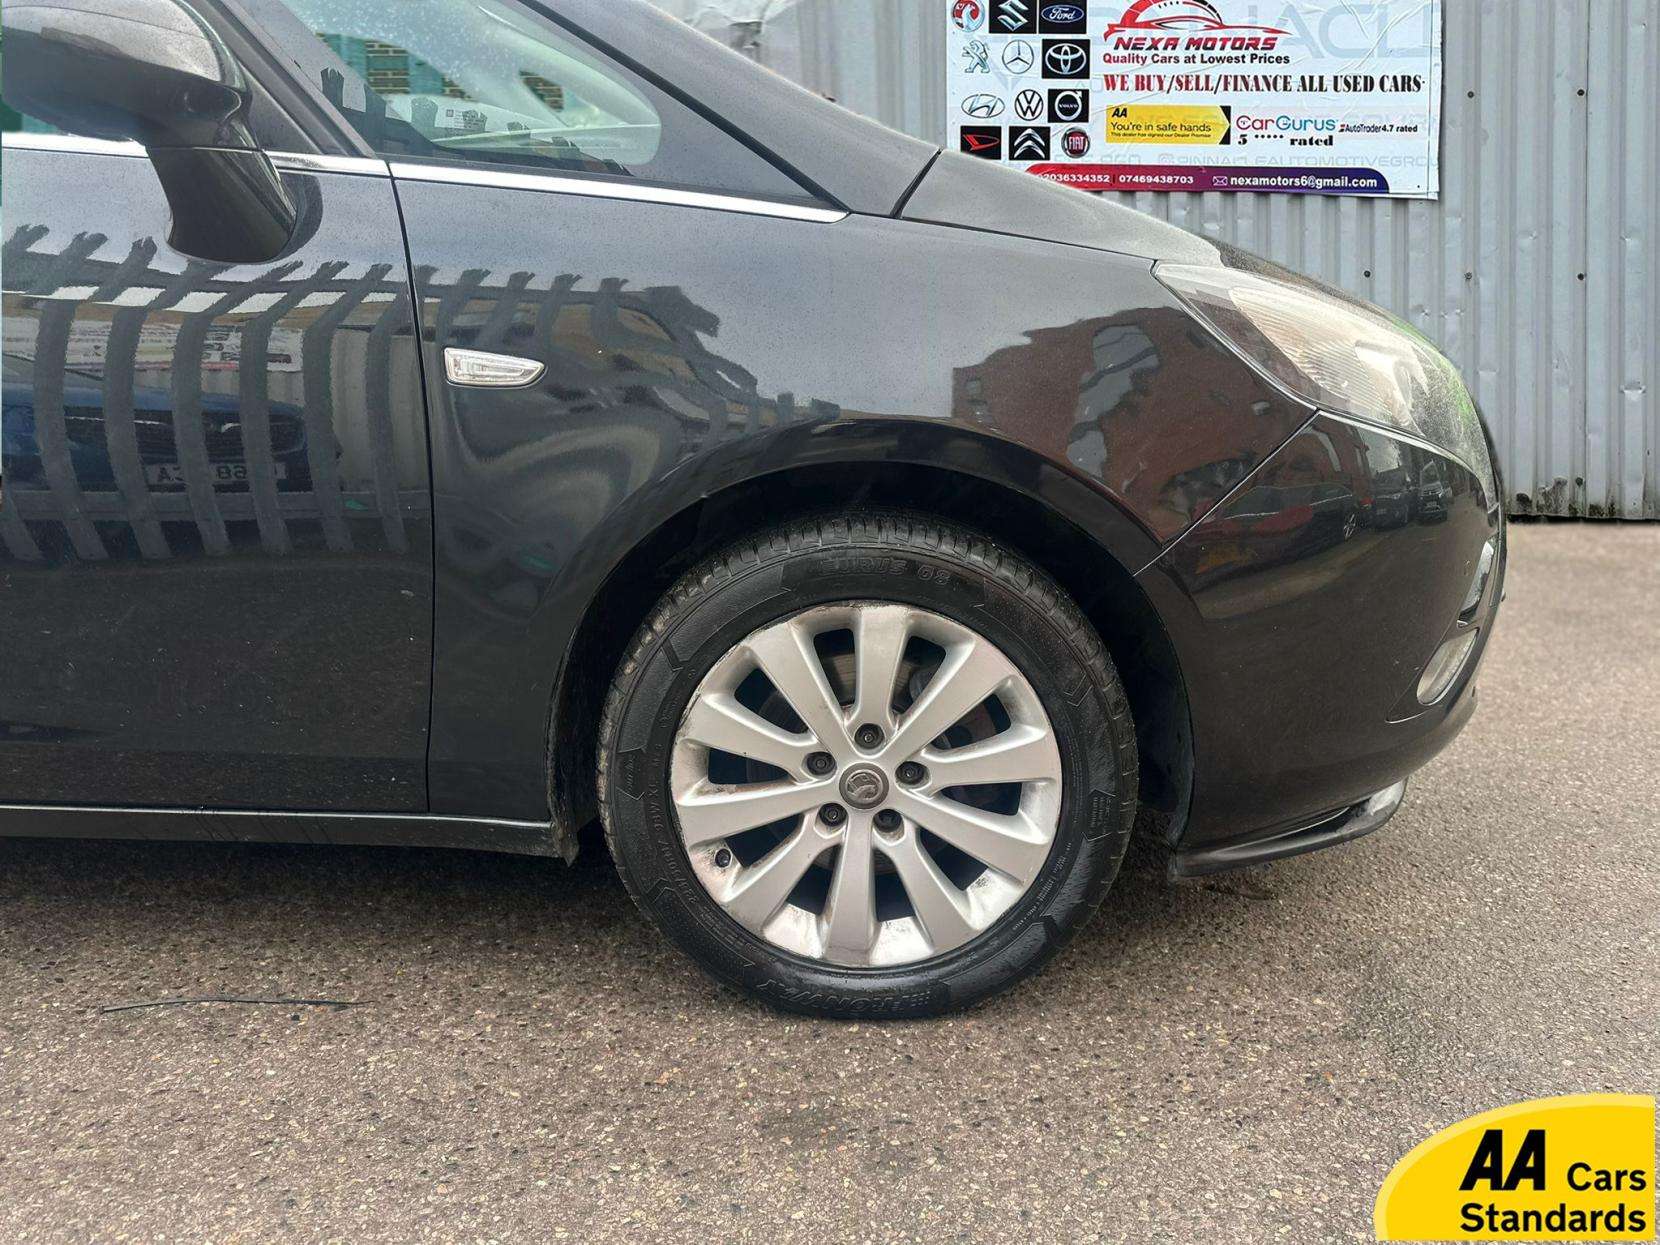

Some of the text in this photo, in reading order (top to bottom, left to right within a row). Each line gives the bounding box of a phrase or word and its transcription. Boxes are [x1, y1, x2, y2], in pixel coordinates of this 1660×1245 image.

[1049, 7, 1076, 20] Ford
[1114, 37, 1278, 51] NEXA MOTORS
[1103, 53, 1290, 66] Quality Cars at Lowest Prices
[1103, 74, 1129, 92] WE
[1134, 74, 1292, 94] BUY/SELL/FINANCE
[1297, 75, 1331, 93] ALL
[1333, 75, 1375, 93] USED
[1379, 75, 1421, 93] CARS
[1112, 107, 1128, 118] AA
[1111, 121, 1212, 132] You're in safe hands
[1236, 115, 1337, 131] CarGurus
[1396, 125, 1418, 133] rated
[1068, 136, 1085, 150] FIAT
[1238, 134, 1334, 146] 5 rated
[1119, 174, 1194, 184] 07469438703
[1230, 176, 1378, 189] nexamotors6@gmail.com
